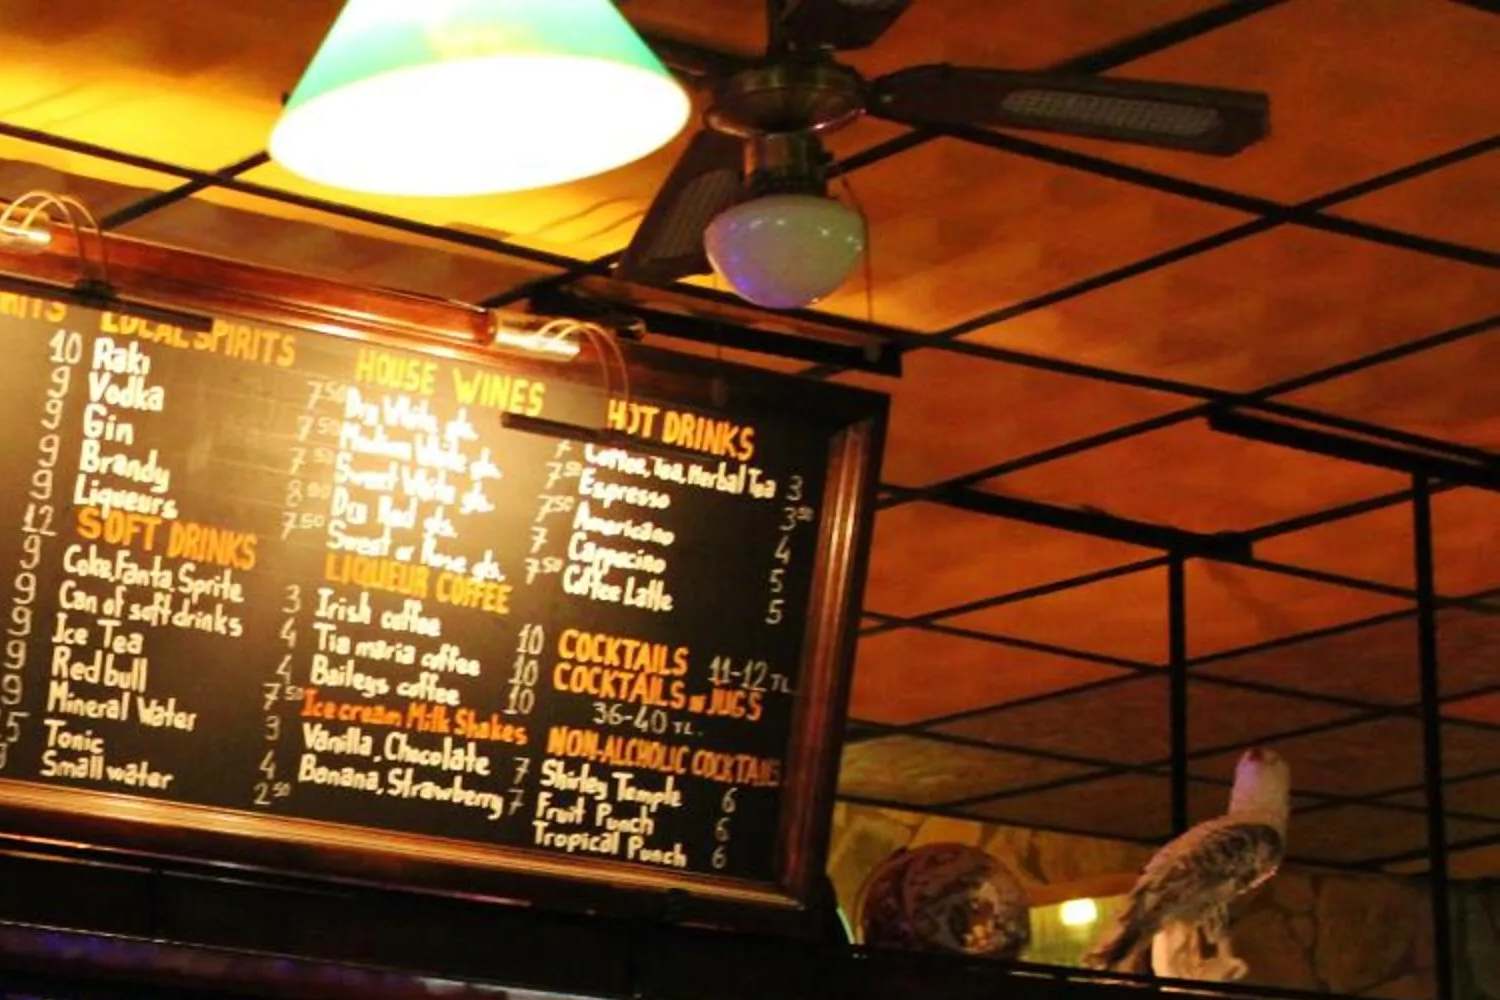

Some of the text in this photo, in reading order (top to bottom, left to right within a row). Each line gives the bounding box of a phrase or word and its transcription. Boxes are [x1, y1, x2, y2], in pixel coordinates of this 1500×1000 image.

[50, 329, 83, 365] 10
[89, 372, 164, 411] Vodka
[355, 349, 437, 395] HOUSE
[453, 368, 545, 416] WINES
[84, 403, 134, 445] Gin
[662, 410, 754, 462] DRINKS
[80, 439, 171, 493] Brandy
[688, 462, 746, 495] Herbal
[749, 468, 776, 499] Tea
[74, 473, 179, 519] Liqueurs
[578, 468, 670, 510] Espresso
[22, 504, 58, 535] 12
[78, 508, 258, 570] SOFT DRINKS
[573, 500, 675, 545] Americano
[179, 563, 244, 604] Sprite
[325, 553, 513, 615] LIQUEUR COFFEE
[623, 576, 674, 612] Latte
[60, 581, 244, 636] Can of soft drinks
[315, 588, 441, 637] Irish coffee
[52, 612, 144, 654] Ice Tea
[313, 622, 481, 677] Tia maria coffee
[558, 628, 689, 676] COCKTAILS
[311, 654, 460, 706] Baileys coffee
[553, 664, 685, 709] COCKTAILS
[48, 681, 197, 732] Mineral Water
[300, 688, 527, 745] Ice cream Milk Shakes
[592, 702, 668, 735] 36-40
[44, 719, 104, 755] Tonic
[384, 732, 490, 776] Chocolate
[40, 751, 174, 790] Small water
[539, 758, 682, 813] Shirley Temple
[388, 768, 503, 820] Strawberry
[536, 791, 654, 836] Fruit Punch
[532, 821, 688, 868] Tropical Punch
